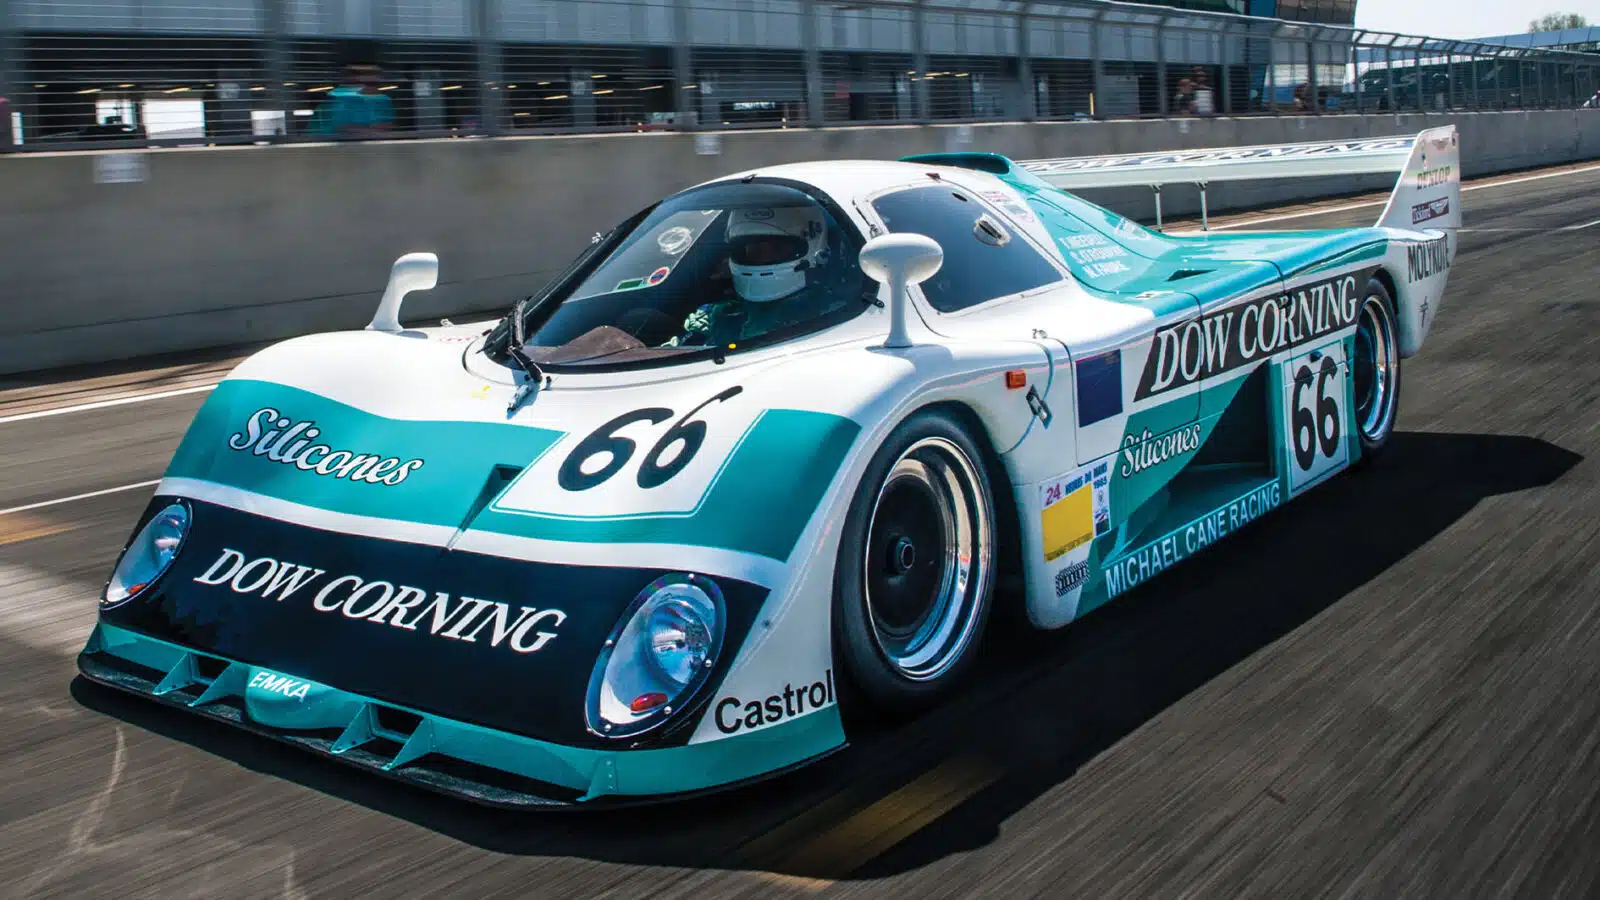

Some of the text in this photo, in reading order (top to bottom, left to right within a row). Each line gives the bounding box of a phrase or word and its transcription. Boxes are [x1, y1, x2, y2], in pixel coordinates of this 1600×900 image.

[1407, 233, 1450, 283] MOLYKOTE
[1151, 276, 1357, 392] DOW CORNING
[228, 407, 424, 486] Silicones
[557, 385, 744, 492] 66
[1121, 424, 1200, 479] Silicones
[1292, 355, 1340, 471] 66
[1045, 483, 1061, 506] 24
[1105, 535, 1182, 599] MICHAEL
[1185, 511, 1226, 553] CANE
[1229, 482, 1281, 531] RACING
[193, 548, 568, 652] DOW CORNING
[248, 671, 311, 699] EMKA
[714, 668, 833, 734] Castrol
